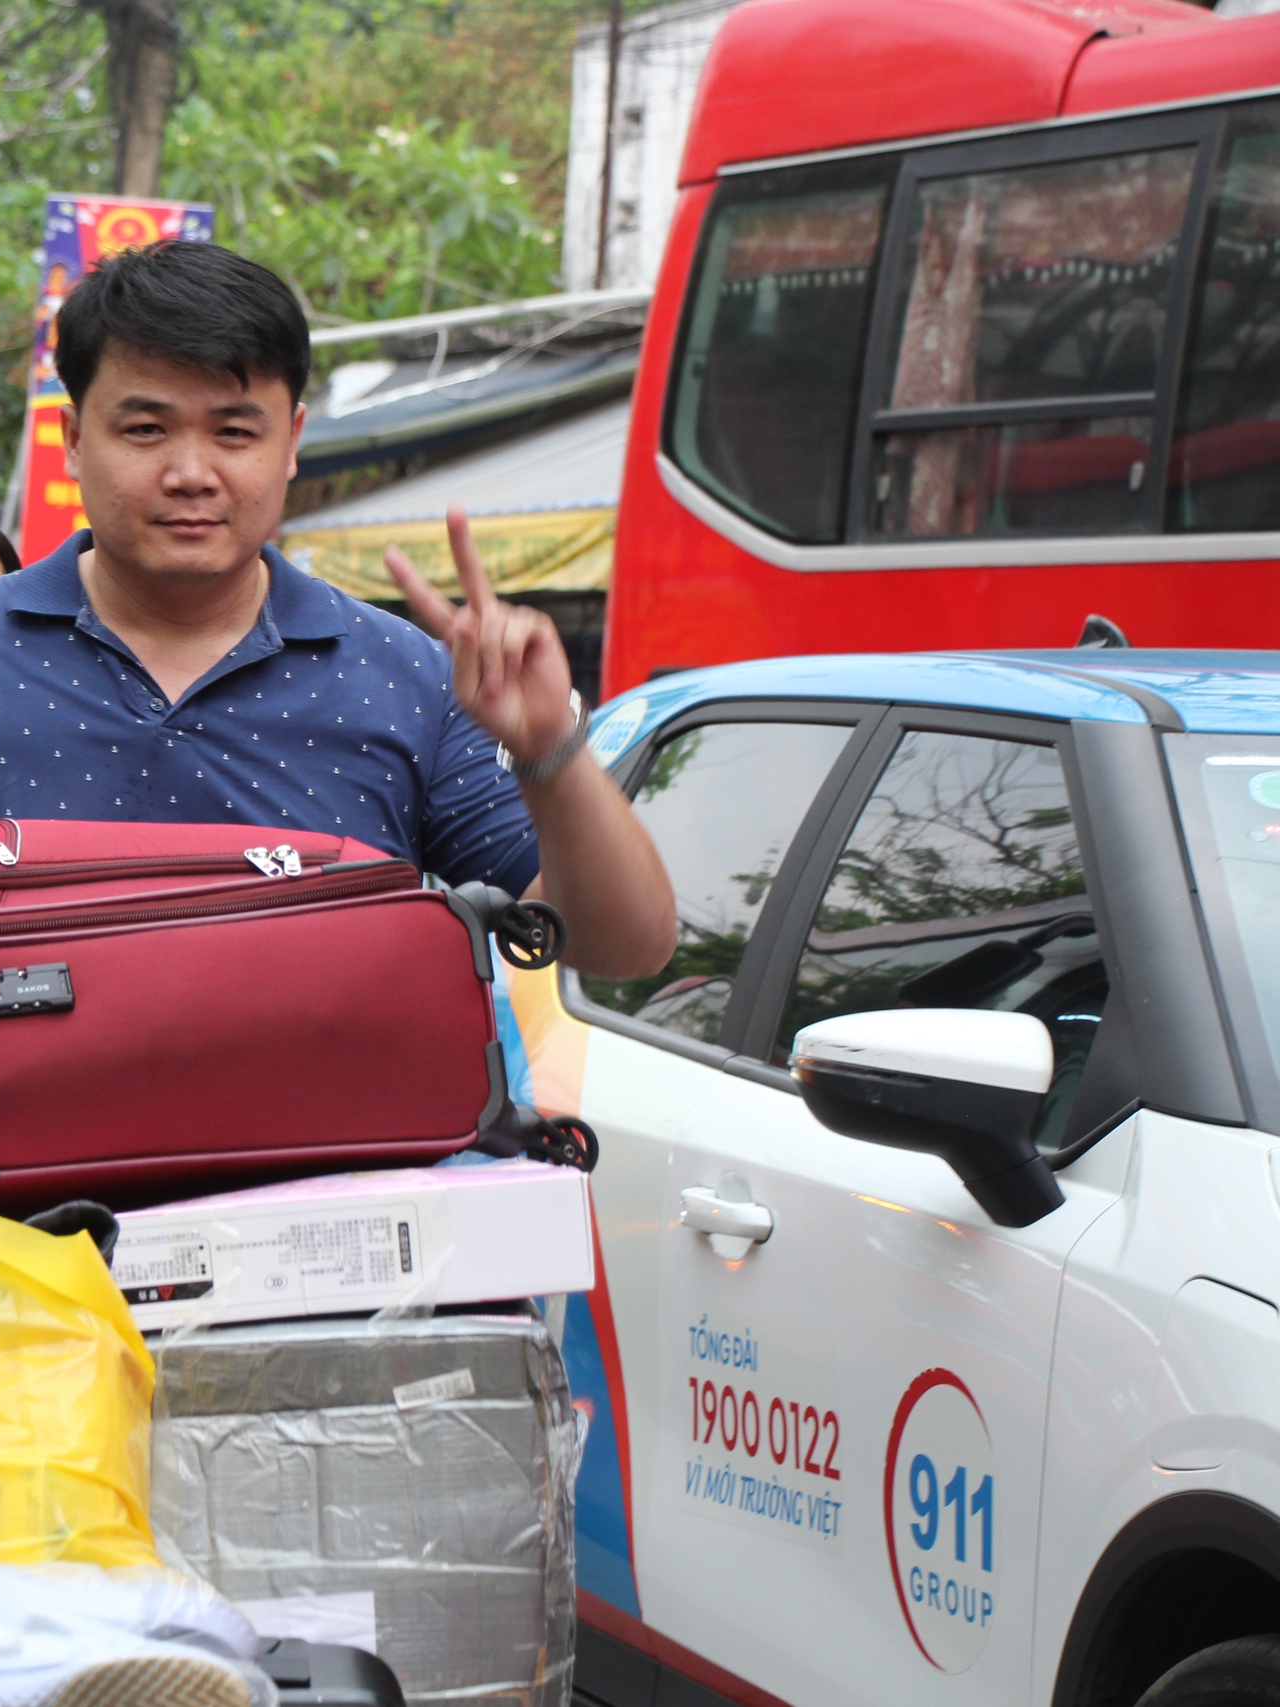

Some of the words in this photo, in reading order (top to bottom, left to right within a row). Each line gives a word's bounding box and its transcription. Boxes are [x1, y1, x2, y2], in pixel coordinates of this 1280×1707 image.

[689, 1313, 730, 1365] TỔNG
[732, 1328, 759, 1372] ĐÀI
[689, 1377, 760, 1457] 1900
[768, 1397, 841, 1481] 0122
[685, 1455, 703, 1497] VÌ
[703, 1460, 736, 1504] MÔI
[739, 1474, 803, 1527] TRƯỜNG
[807, 1490, 842, 1541] VIỆT
[909, 1453, 994, 1573] 911
[910, 1566, 993, 1628] GROUP
